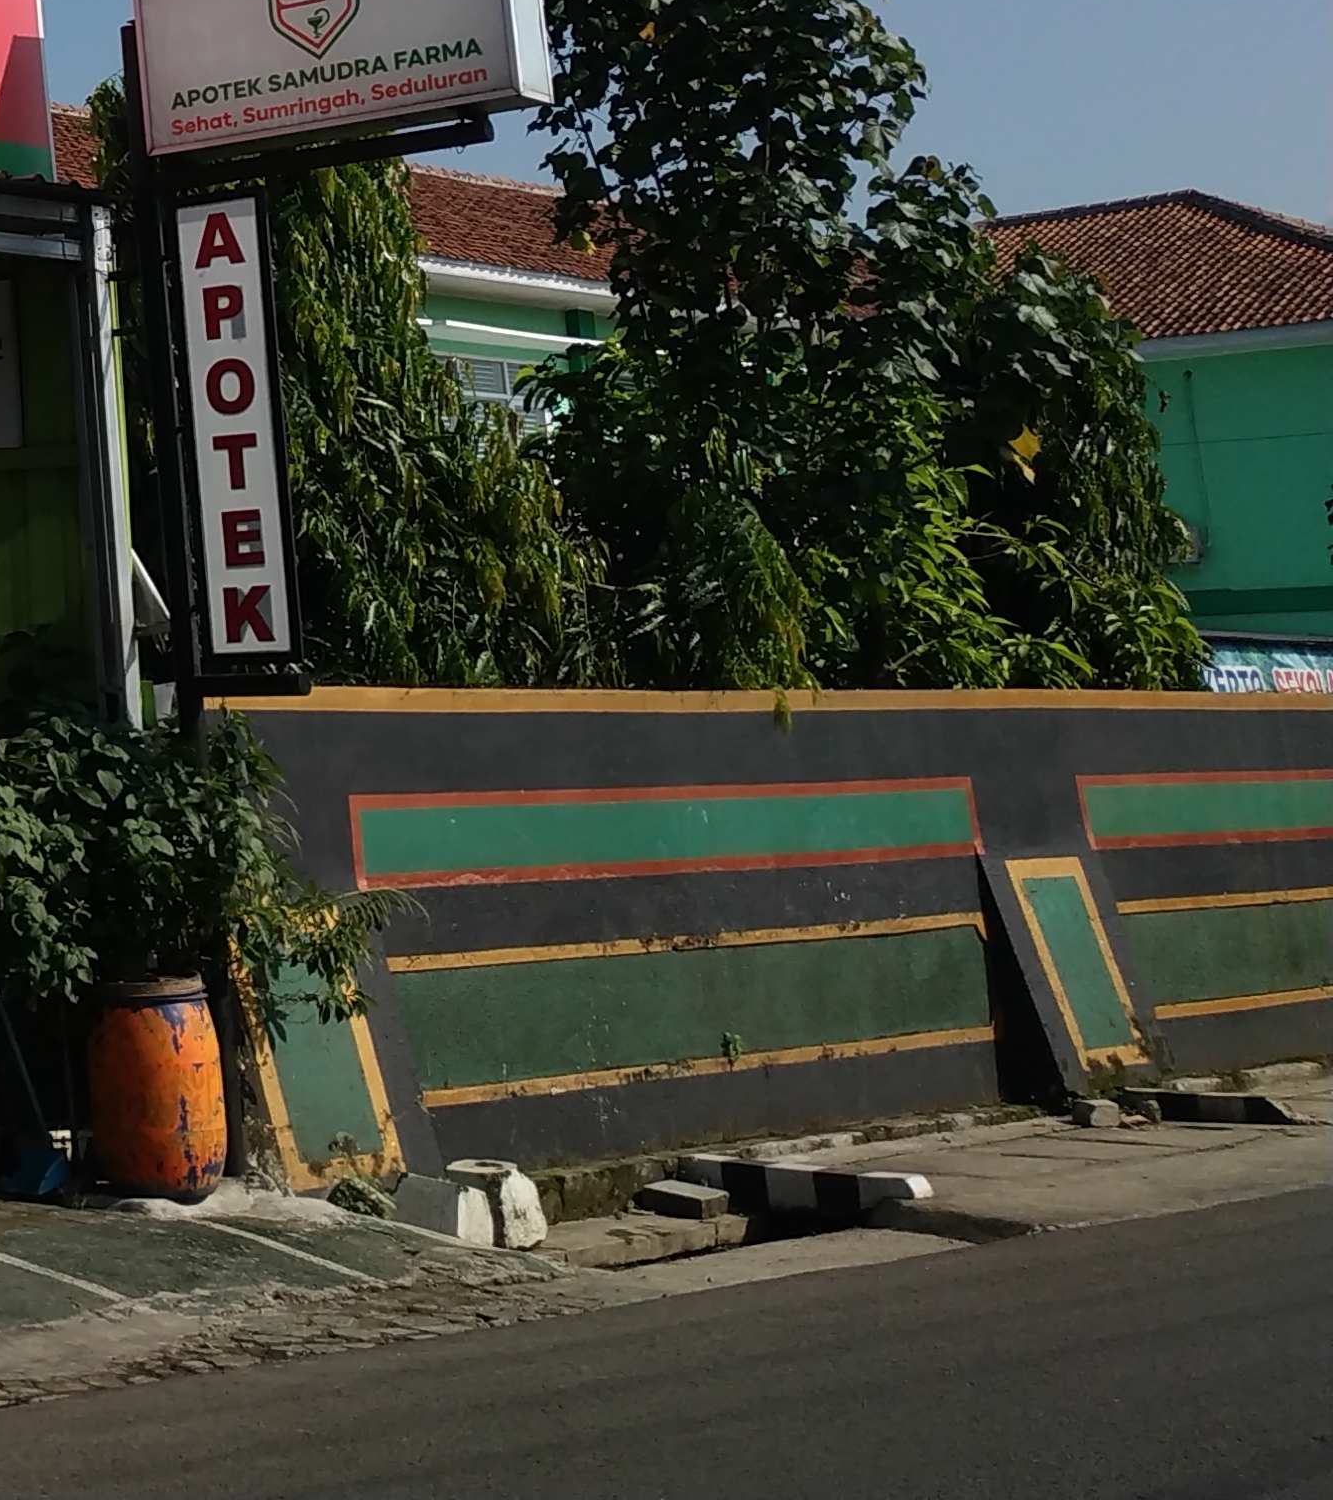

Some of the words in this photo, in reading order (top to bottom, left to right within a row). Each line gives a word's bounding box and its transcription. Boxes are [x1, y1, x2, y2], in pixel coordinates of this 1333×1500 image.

[171, 76, 263, 111] APOTEK
[267, 53, 388, 93] SAMUDRA
[393, 37, 483, 71] FARMA
[171, 111, 239, 137] Sehat,
[242, 90, 366, 125] Sumringah,
[370, 67, 488, 102] Seduluran
[194, 211, 277, 645] APOTEK
